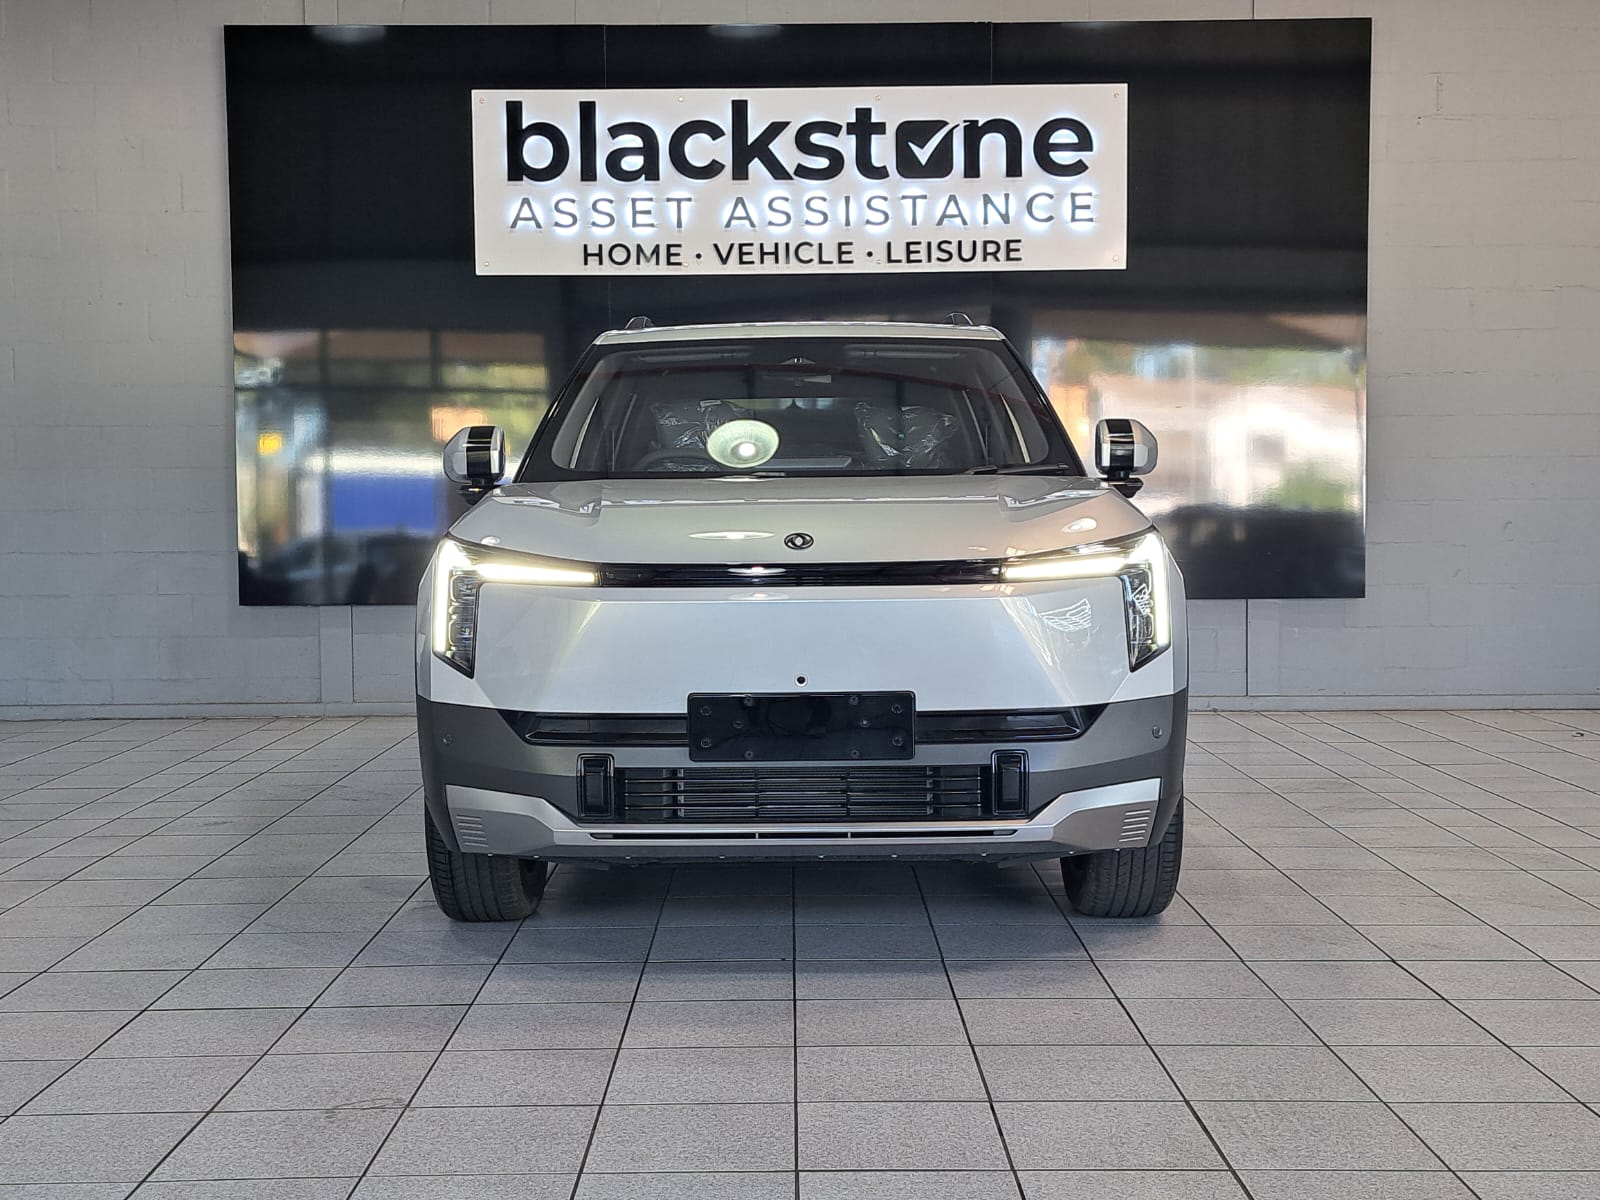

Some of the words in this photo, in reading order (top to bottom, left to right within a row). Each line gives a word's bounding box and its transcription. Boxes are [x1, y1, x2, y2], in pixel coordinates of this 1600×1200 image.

[510, 197, 692, 229] ASSET
[724, 192, 1094, 228] ASSISTANCE
[583, 243, 682, 266] HOME
[713, 241, 854, 265] VEHICLE
[886, 239, 1023, 264] LEISURE
